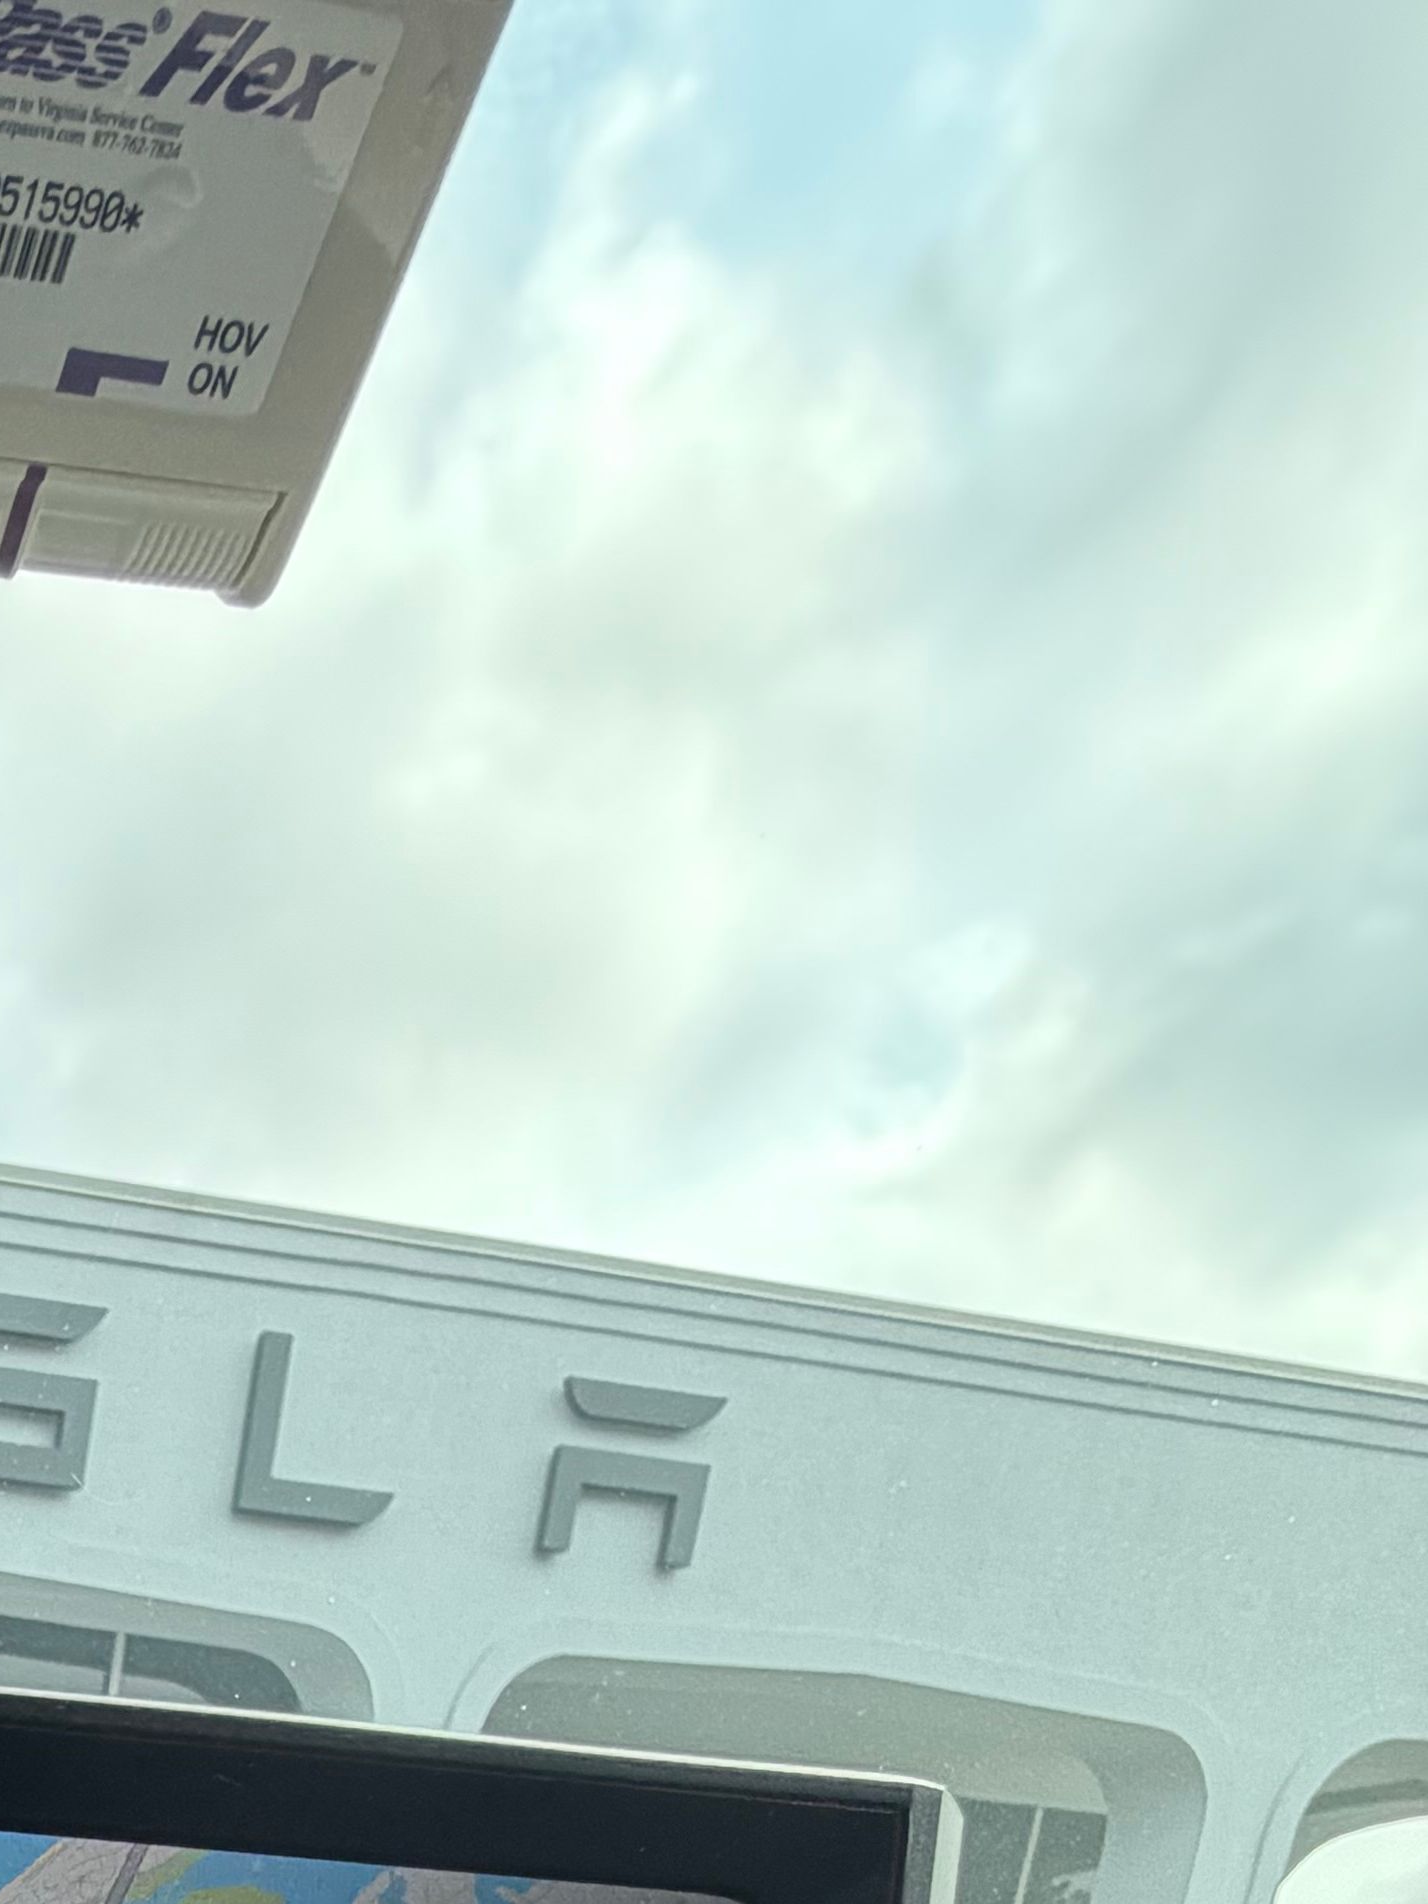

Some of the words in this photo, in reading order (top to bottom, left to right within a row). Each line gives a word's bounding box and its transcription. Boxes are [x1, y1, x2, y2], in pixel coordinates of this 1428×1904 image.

[138, 11, 359, 122] Flex
[18, 97, 34, 114] to
[38, 96, 88, 123] Virginia
[90, 104, 139, 131] Service
[194, 315, 269, 358] HOV
[186, 363, 238, 399] ON
